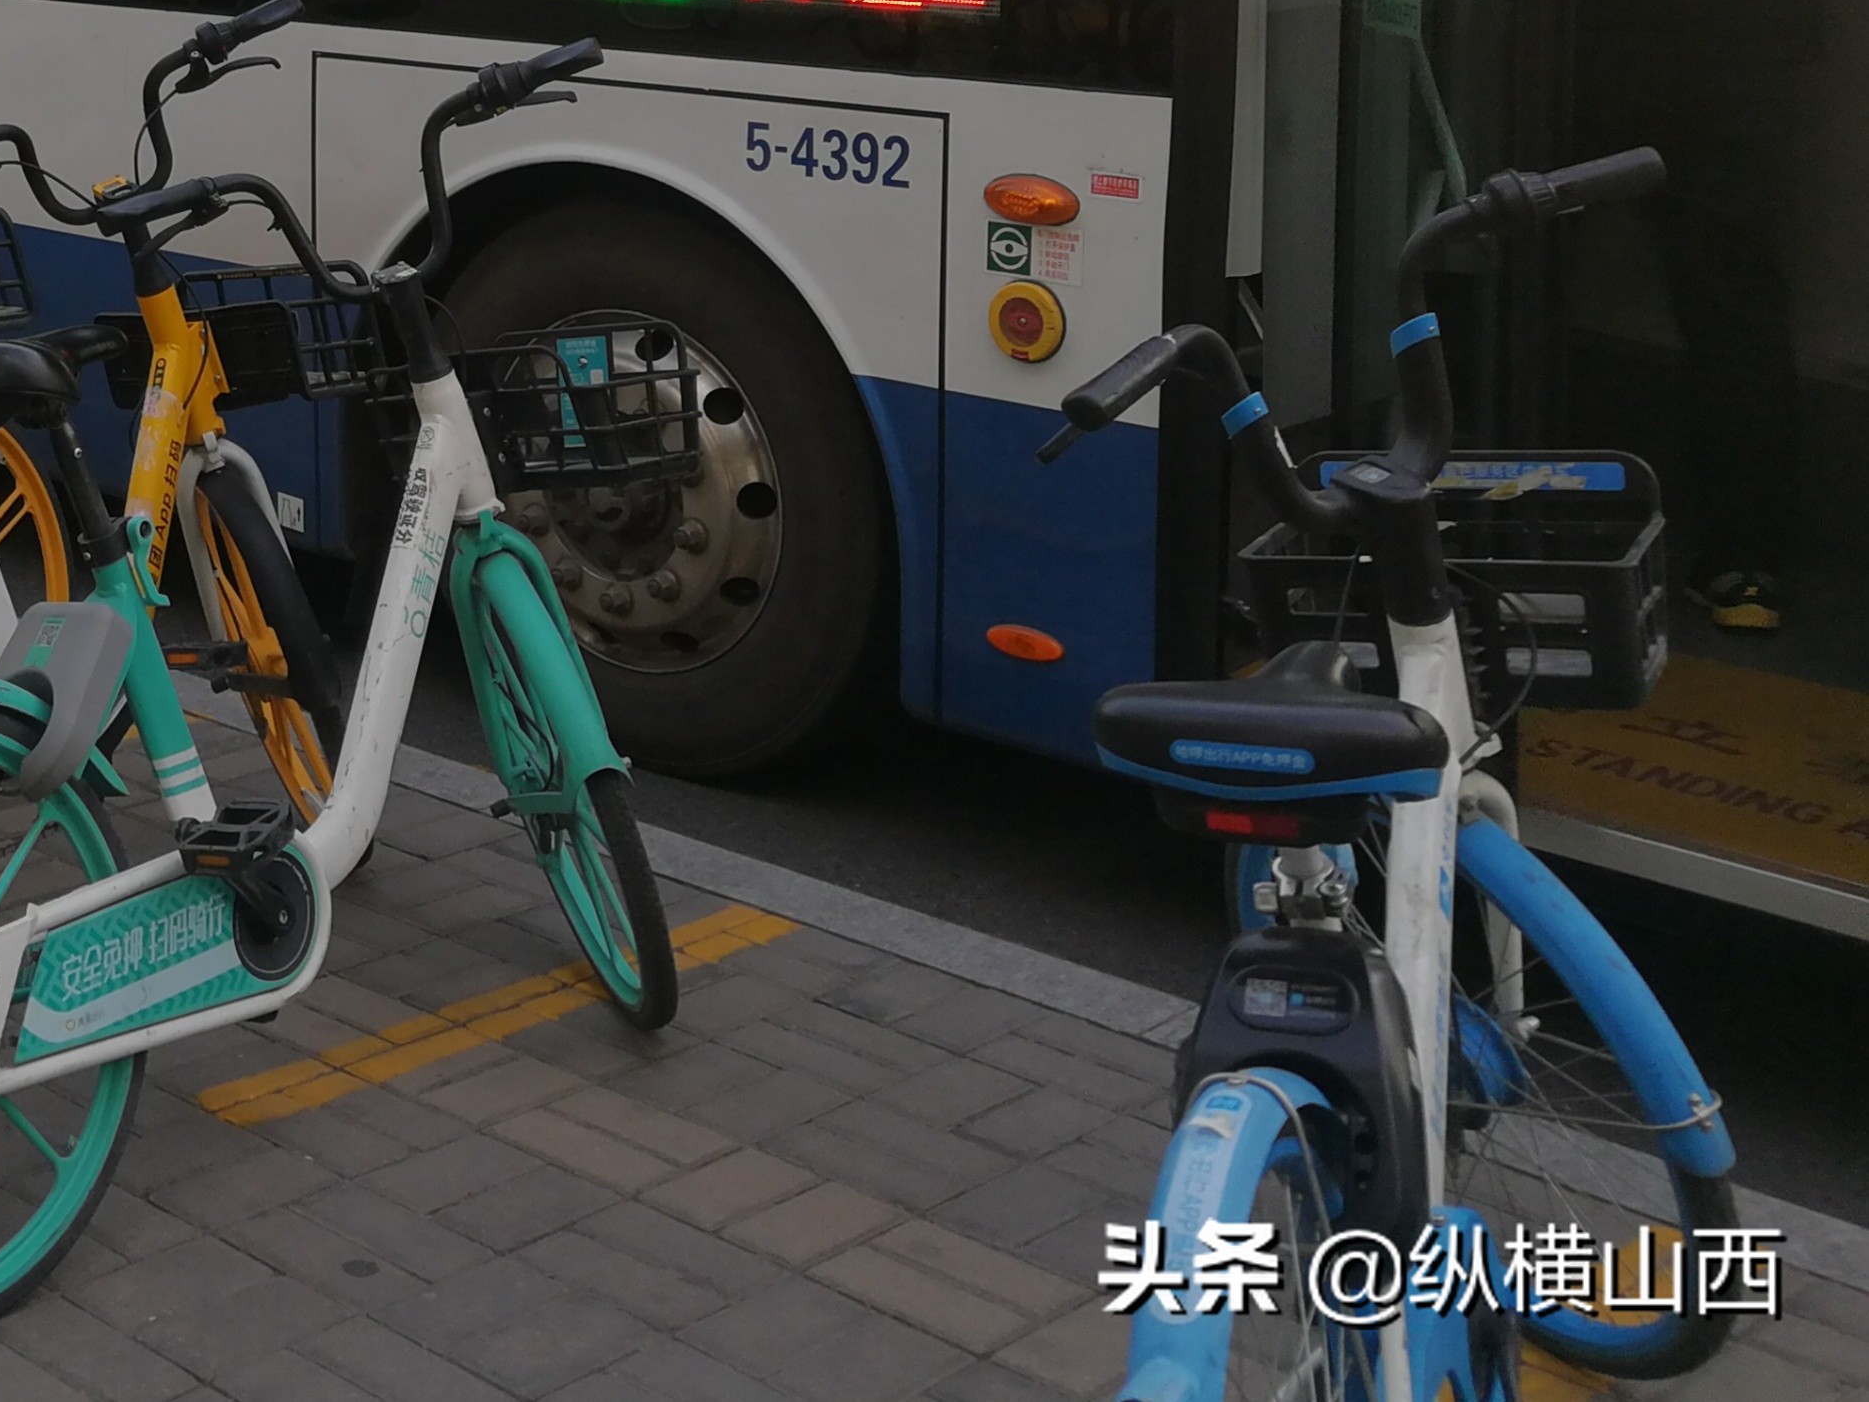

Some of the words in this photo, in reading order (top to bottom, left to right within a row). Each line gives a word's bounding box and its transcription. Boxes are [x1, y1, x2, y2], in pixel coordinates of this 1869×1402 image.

[746, 121, 910, 189] 5-4392
[1524, 736, 1832, 826] STANDING
[61, 926, 144, 1002] 安全免押
[148, 895, 226, 965] 扫码骑行
